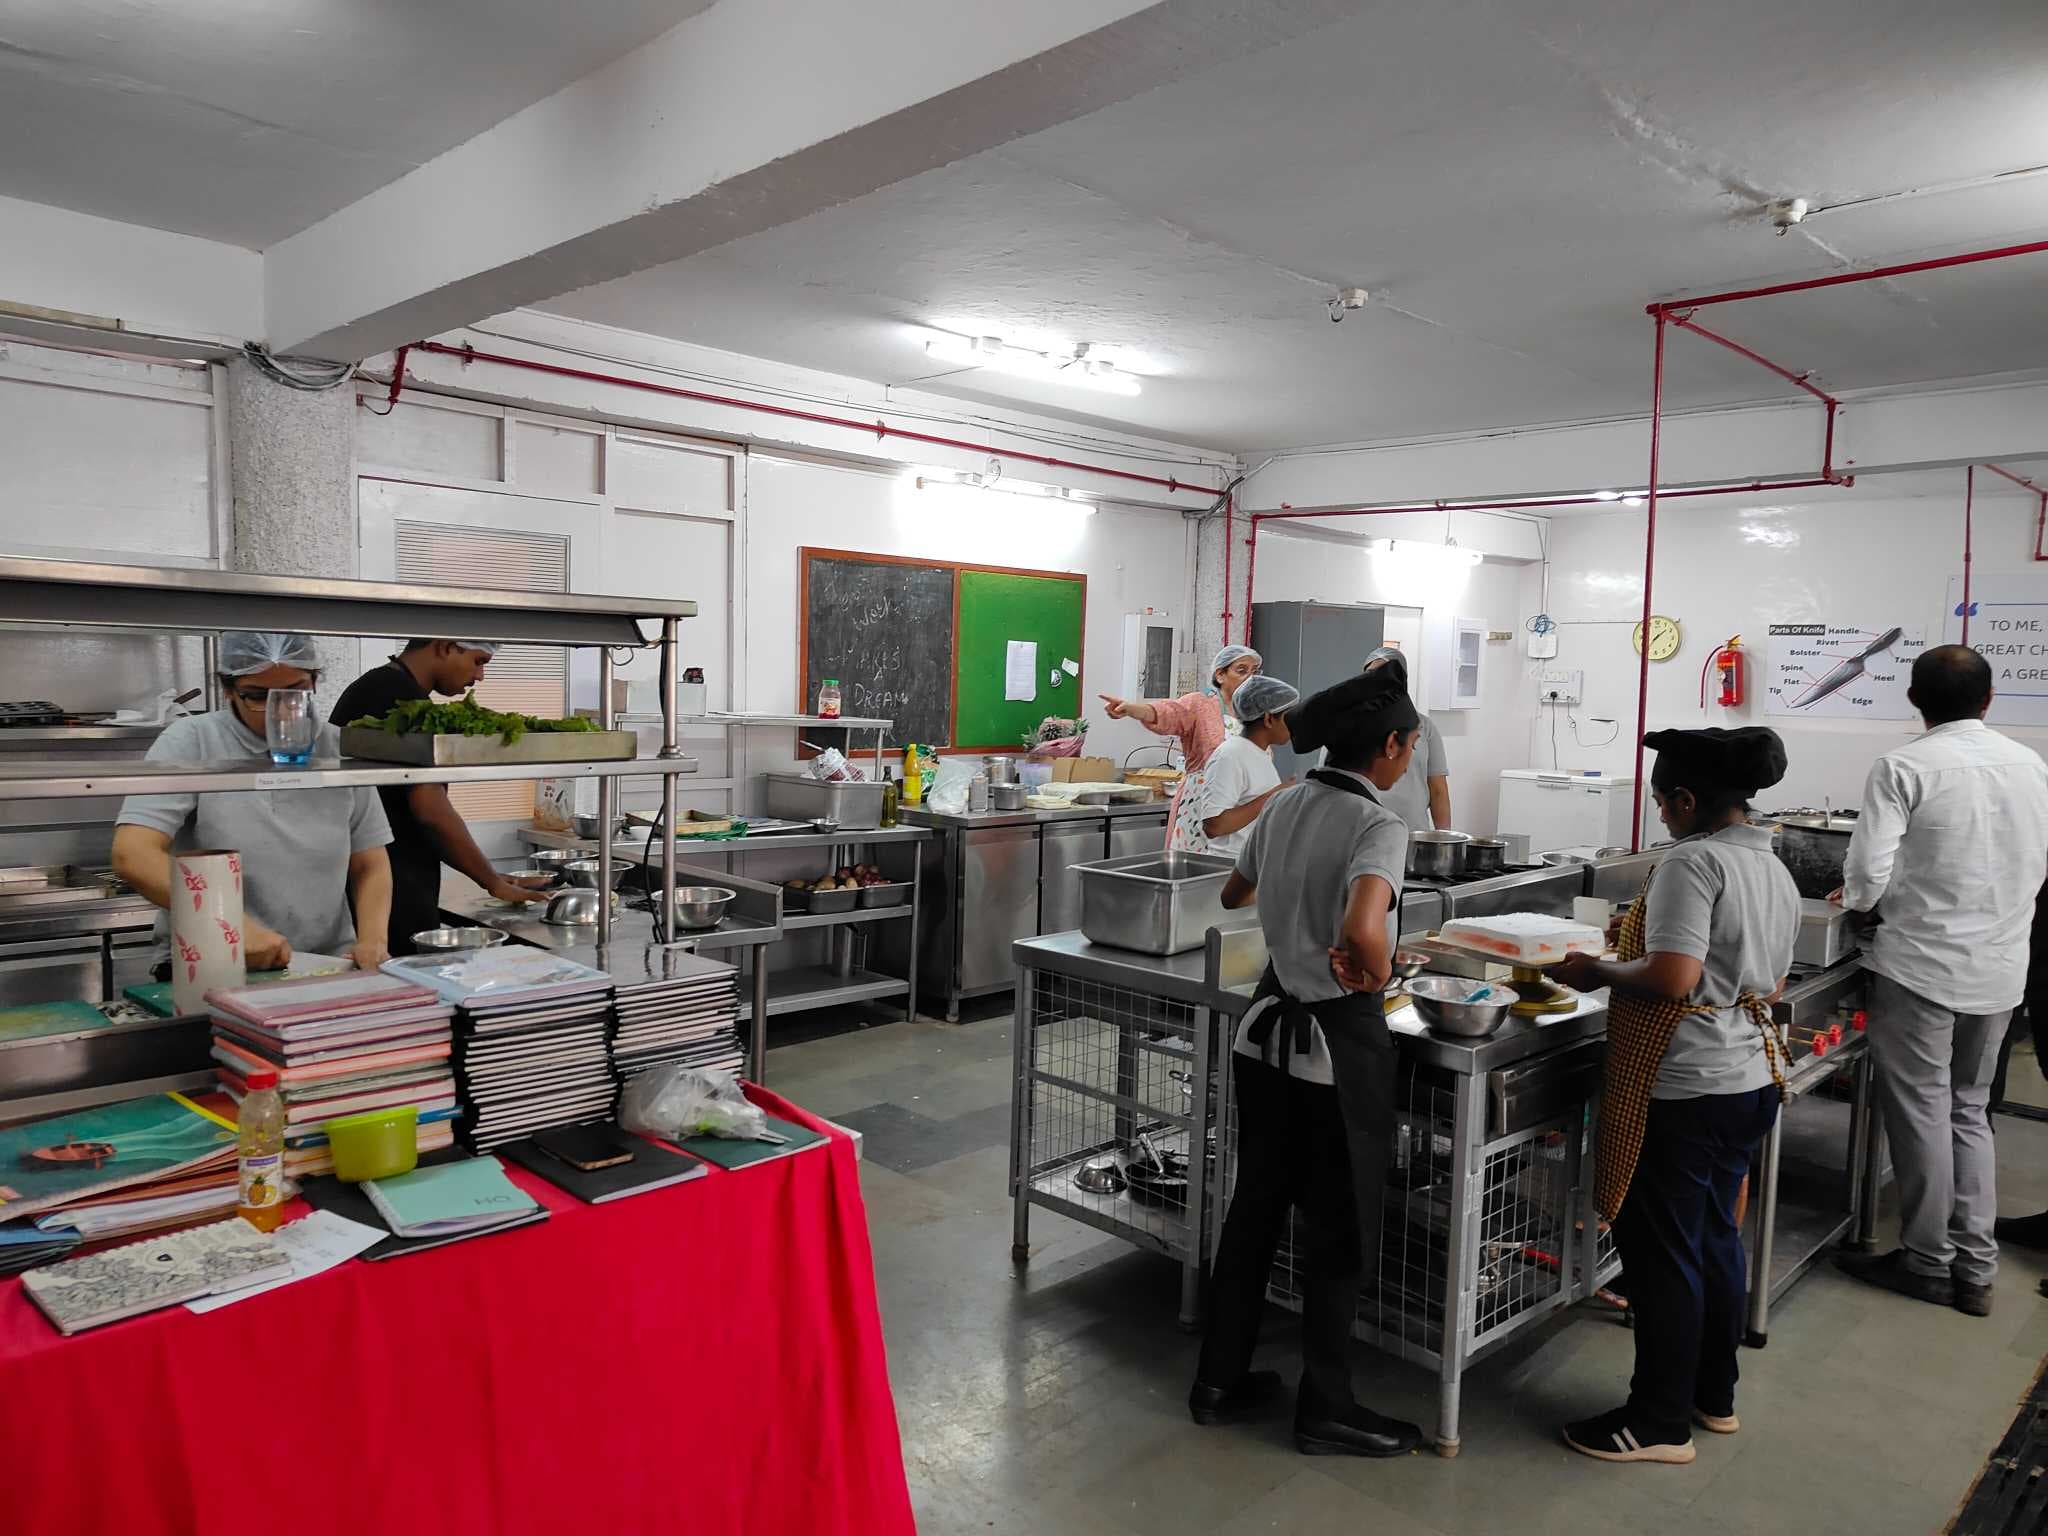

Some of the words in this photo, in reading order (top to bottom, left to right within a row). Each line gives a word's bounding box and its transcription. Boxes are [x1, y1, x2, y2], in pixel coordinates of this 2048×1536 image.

[1769, 626, 1790, 635] Parts
[1791, 626, 1802, 635] Of
[1802, 626, 1825, 635] Knife
[1828, 627, 1860, 635] Handle
[1989, 620, 2011, 631] TO
[2015, 620, 2043, 633] ME,
[1903, 639, 1925, 647] Butt
[1974, 644, 2025, 656] GREAT
[1895, 656, 1914, 665] Tan
[1780, 664, 1804, 672] Spine
[1874, 674, 1896, 682] Heel
[2001, 668, 2012, 680] A
[1769, 687, 1782, 695] Tip
[1851, 697, 1873, 706] Edge
